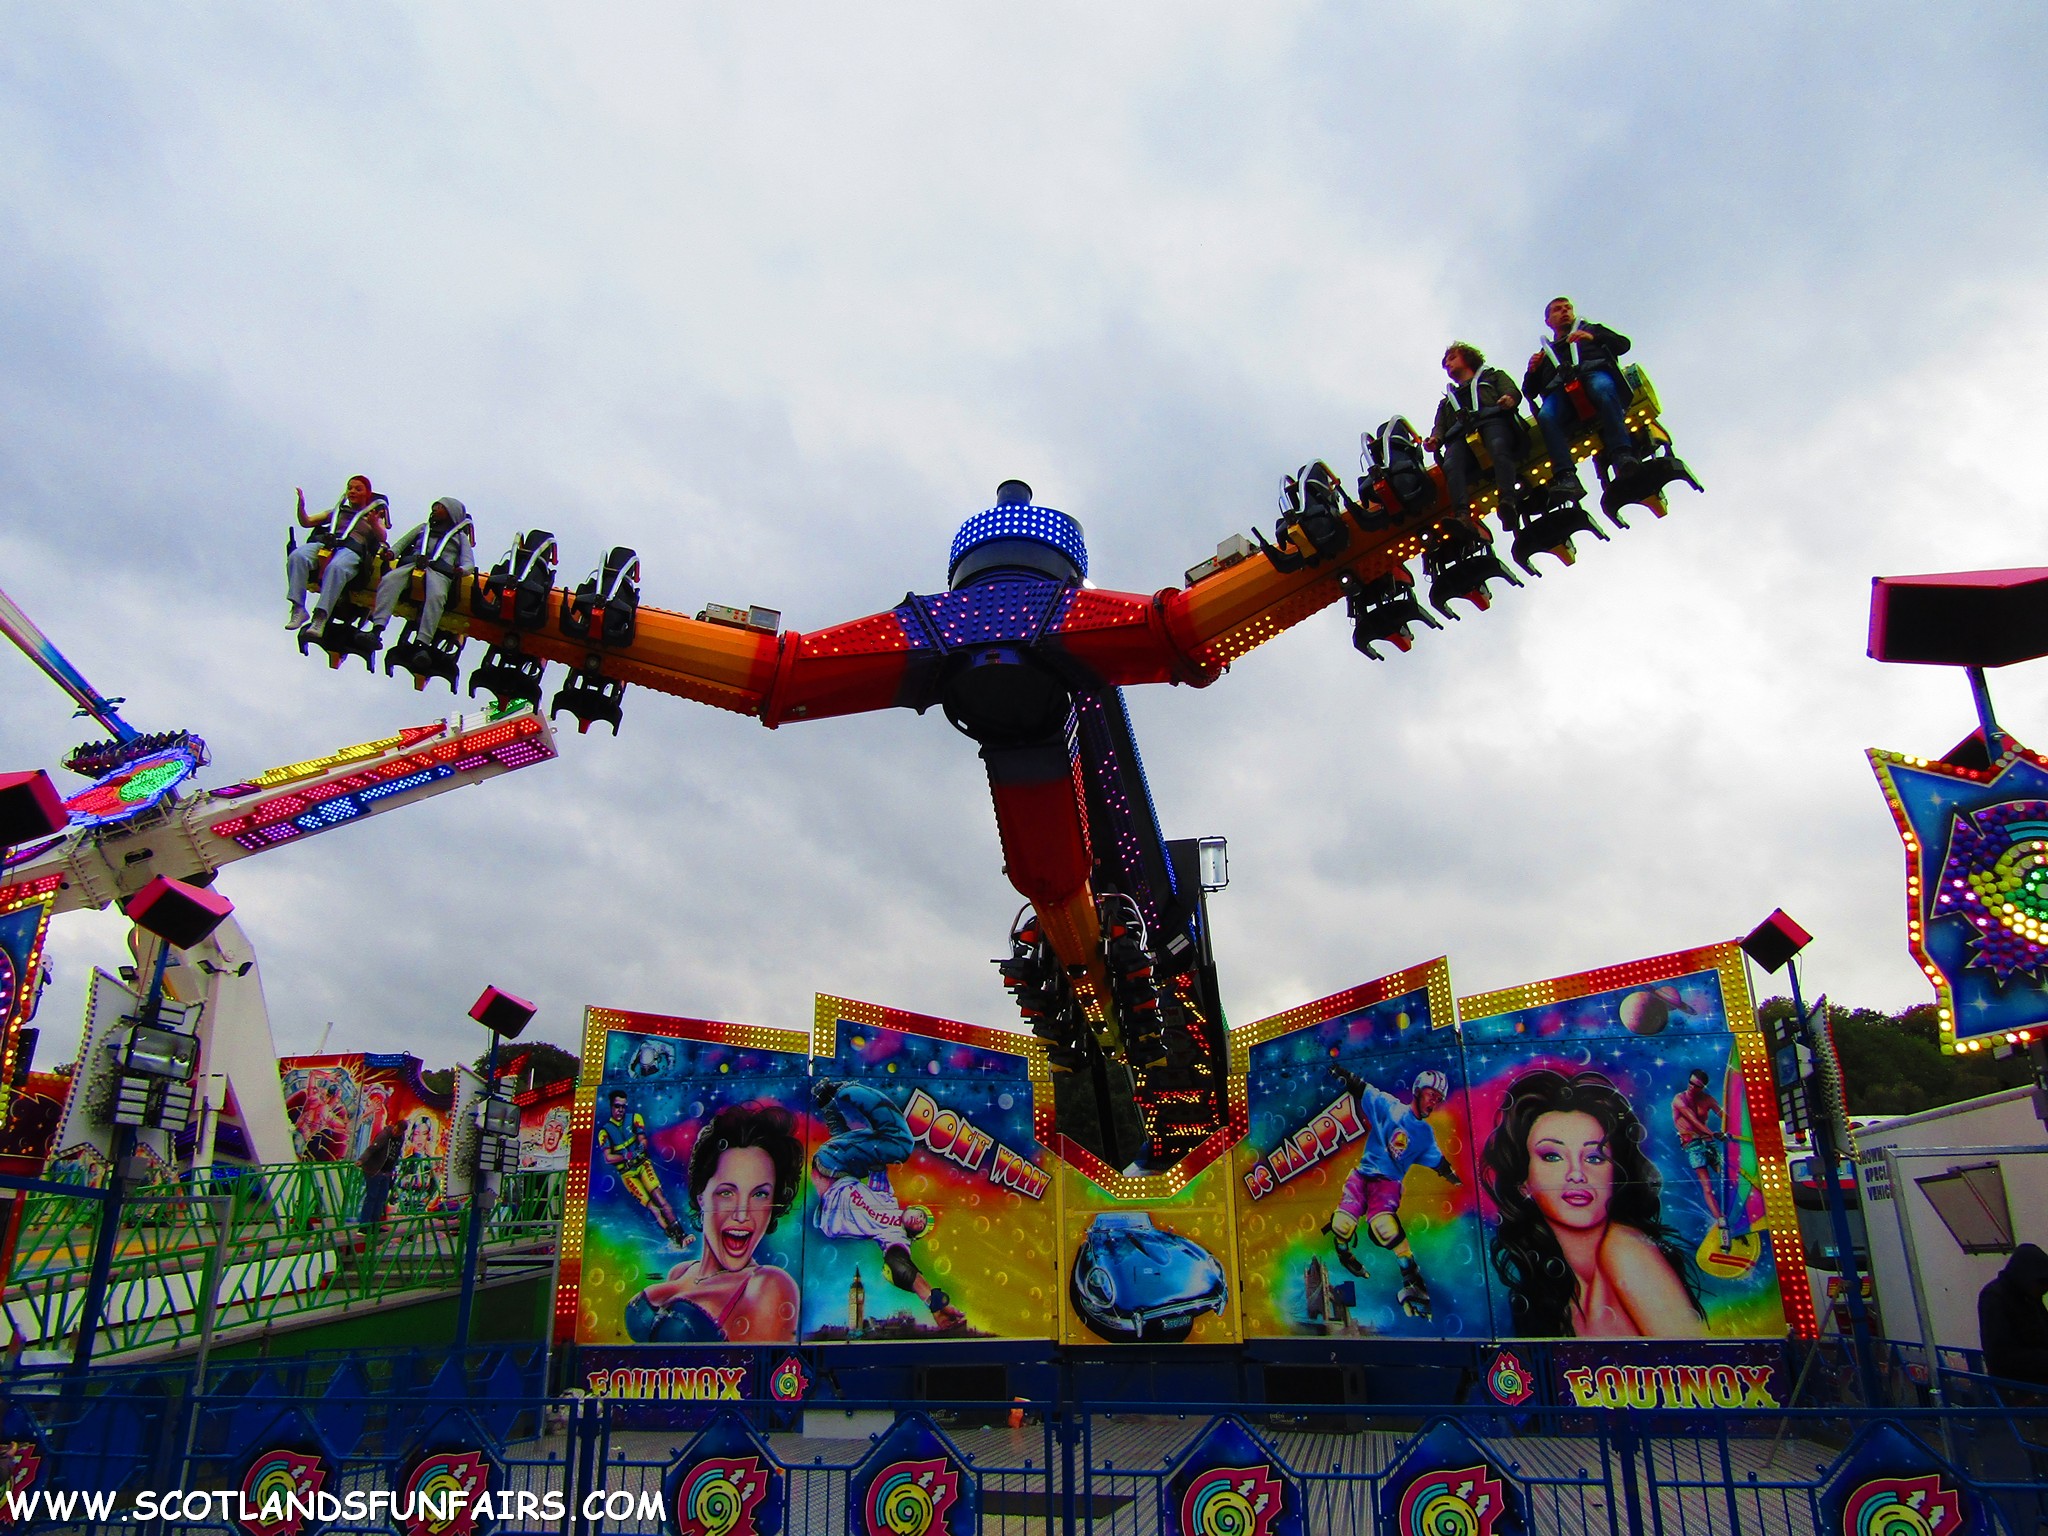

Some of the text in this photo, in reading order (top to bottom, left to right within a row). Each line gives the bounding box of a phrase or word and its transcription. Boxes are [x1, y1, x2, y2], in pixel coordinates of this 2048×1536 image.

[1267, 1091, 1365, 1183] HAPPY
[587, 1366, 746, 1400] EQUINOX
[1564, 1365, 1780, 1409] EQUINOX
